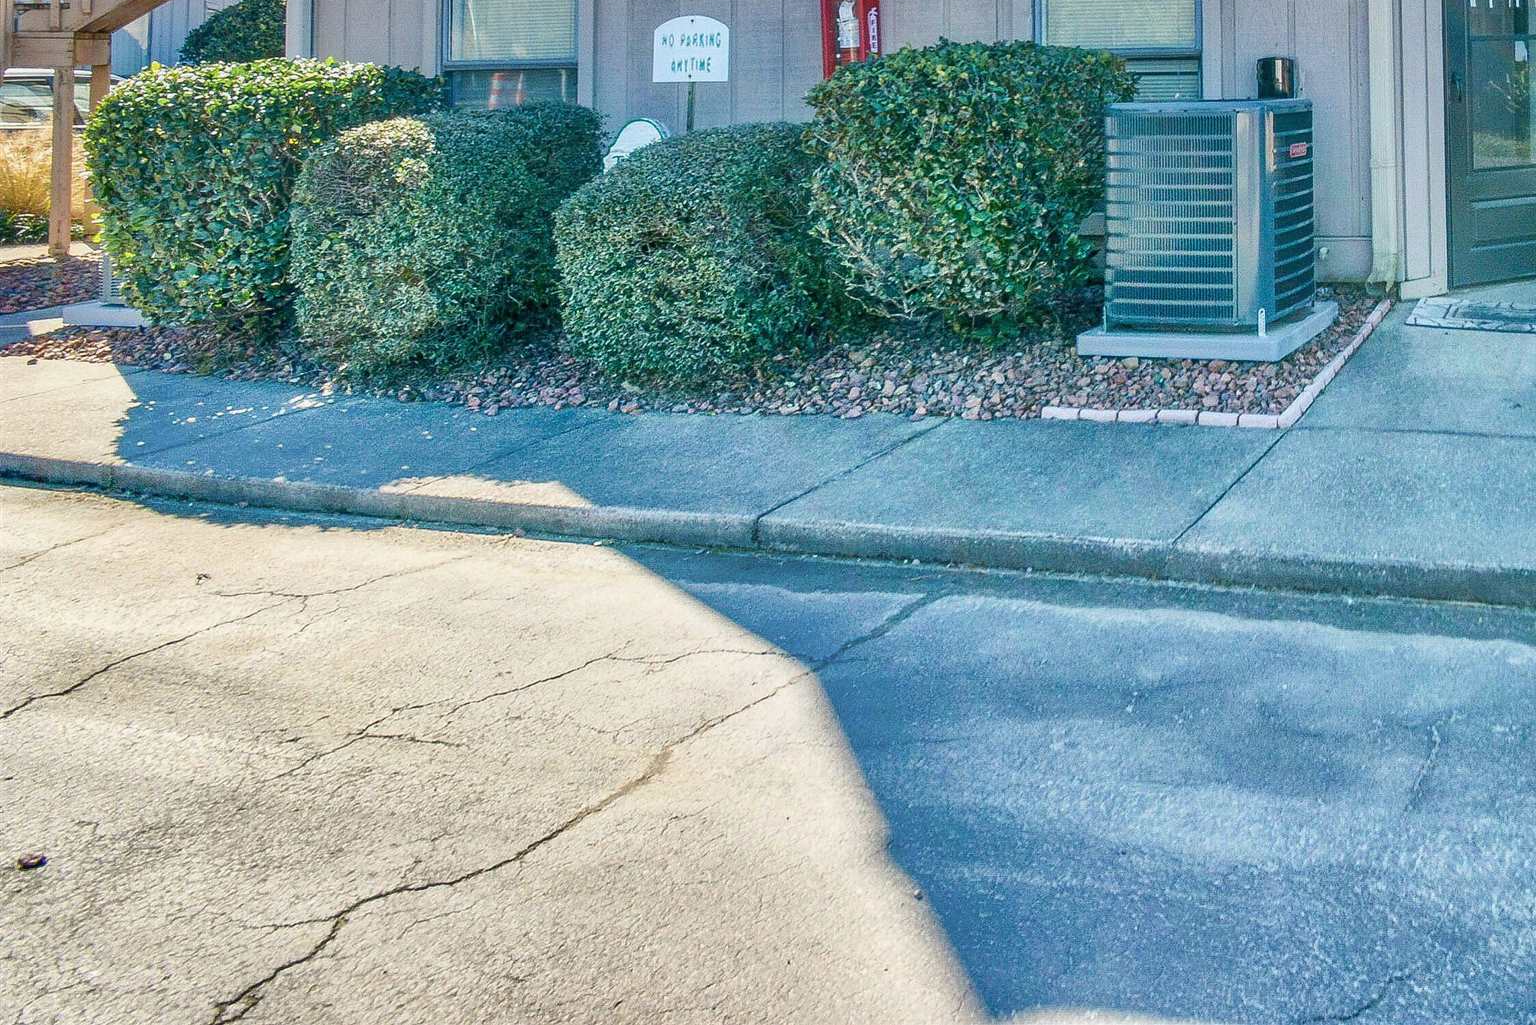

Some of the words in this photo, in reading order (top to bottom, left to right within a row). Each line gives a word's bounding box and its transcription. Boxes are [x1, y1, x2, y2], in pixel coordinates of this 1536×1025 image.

[662, 34, 674, 47] NO
[680, 32, 721, 48] PARKING
[671, 57, 711, 73] ANYTIME
